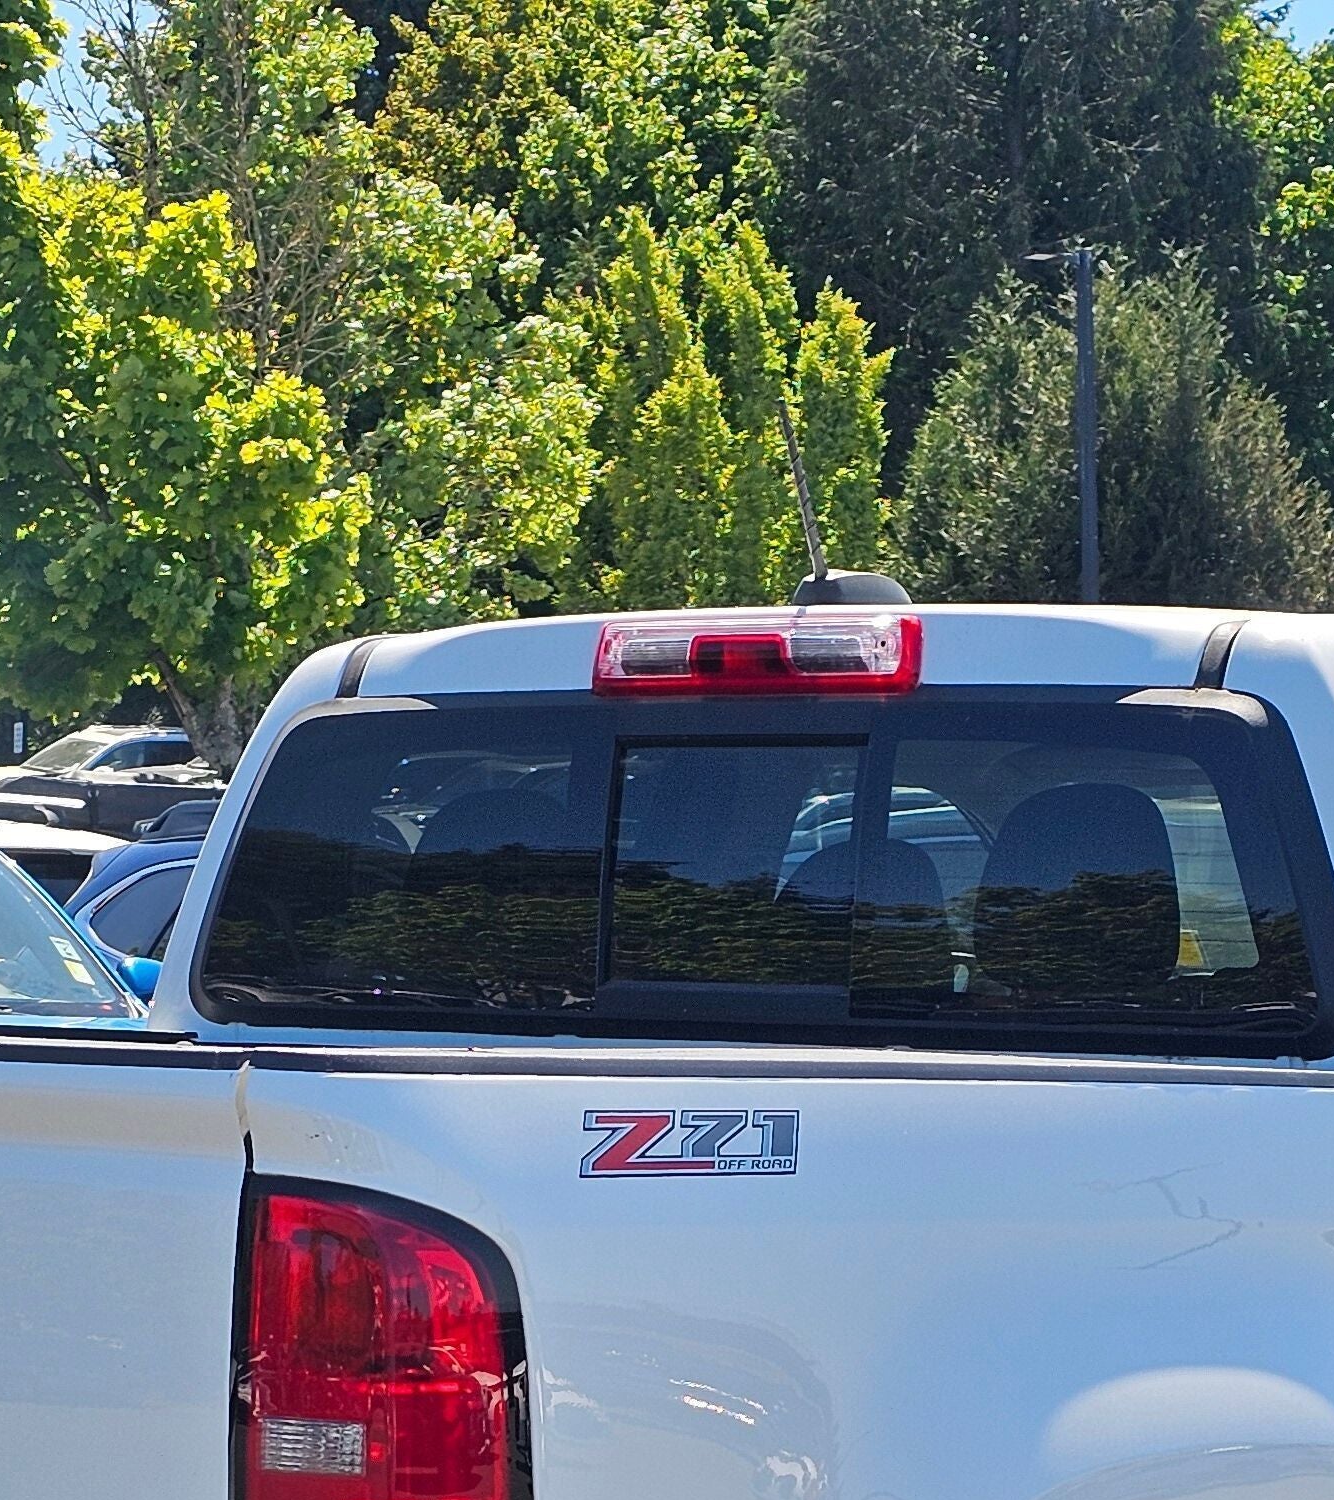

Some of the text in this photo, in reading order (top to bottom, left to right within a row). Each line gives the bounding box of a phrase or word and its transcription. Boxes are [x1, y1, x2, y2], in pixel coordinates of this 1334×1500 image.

[579, 1110, 799, 1178] Z71
[717, 1159, 793, 1170] OFF ROAD
